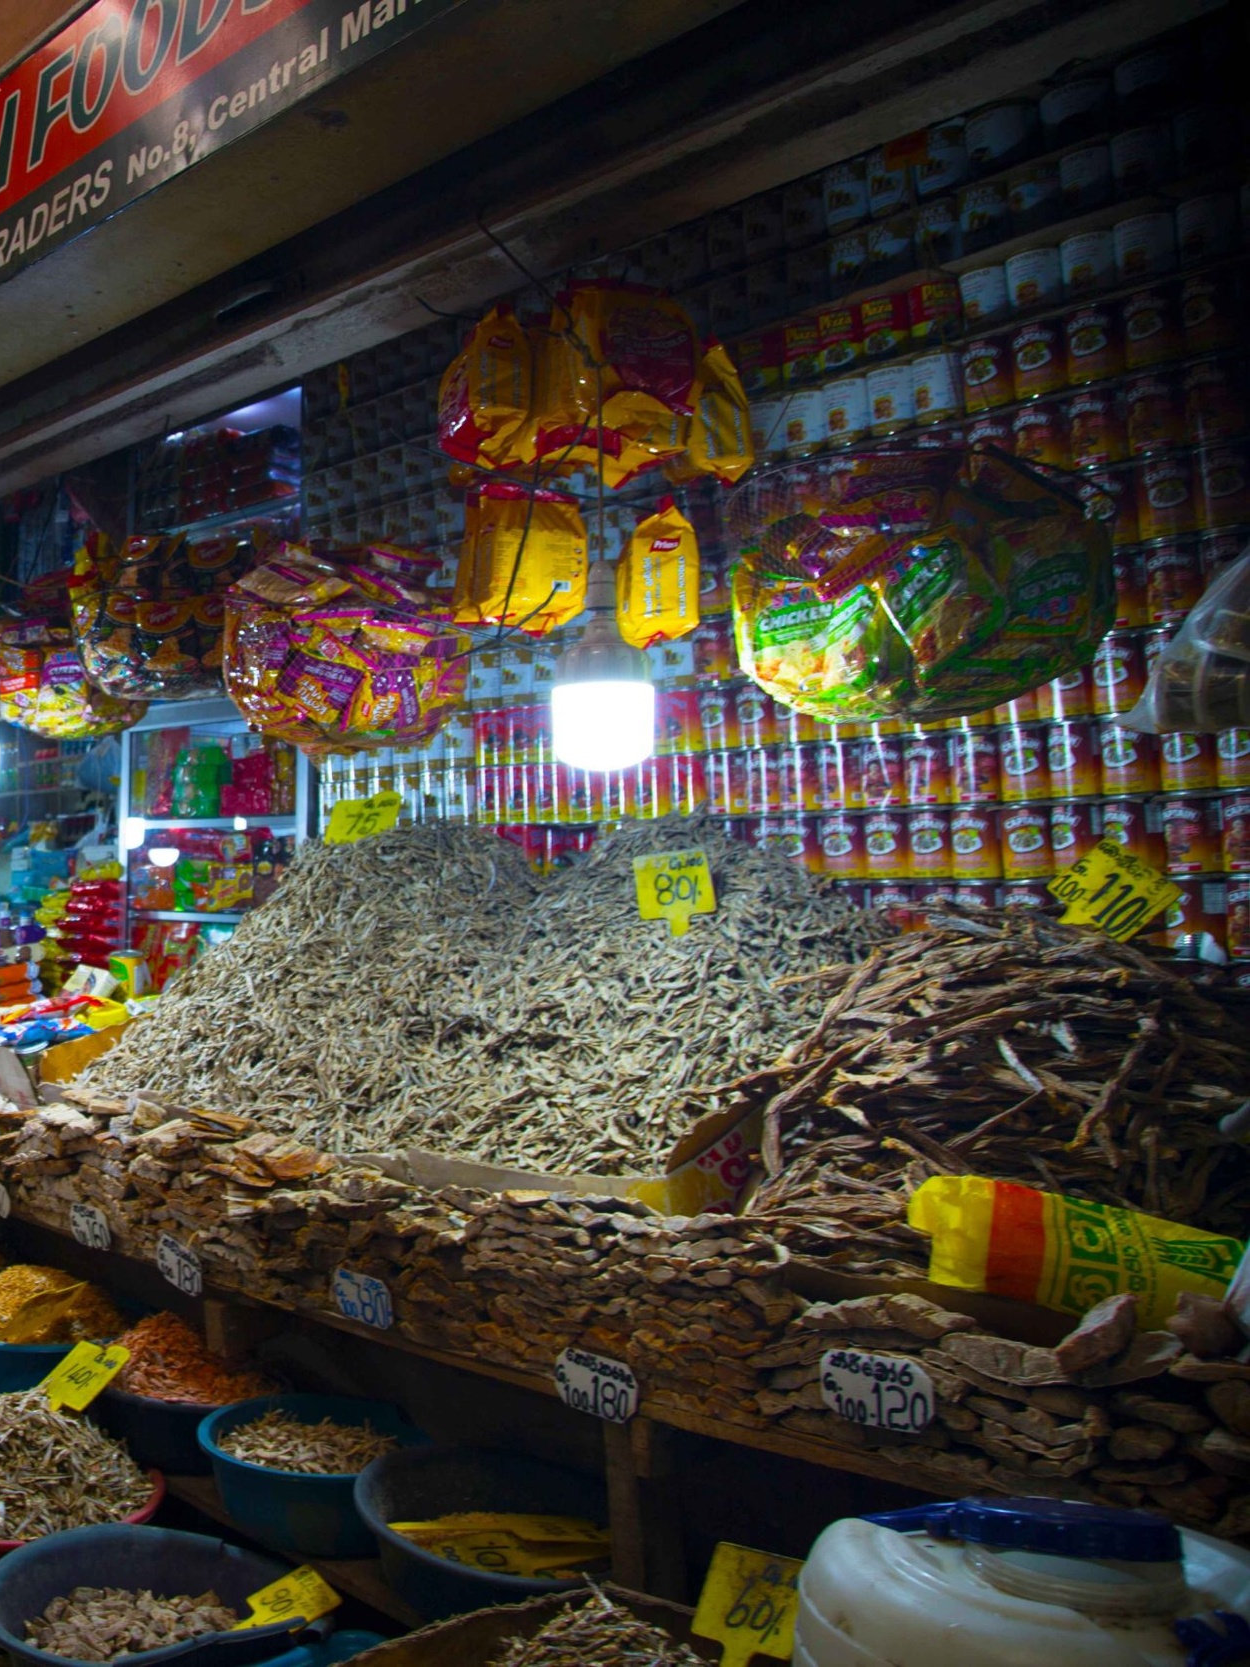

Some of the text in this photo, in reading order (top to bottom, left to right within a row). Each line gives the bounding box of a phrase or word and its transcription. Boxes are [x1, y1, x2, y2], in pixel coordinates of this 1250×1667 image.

[27, 0, 275, 172] FOOD
[126, 120, 196, 185] No.8,
[207, 27, 328, 131] Central
[652, 539, 680, 550] Prima
[759, 603, 834, 632] CHICKEN
[591, 1375, 629, 1420] 180
[871, 1381, 928, 1430] 120
